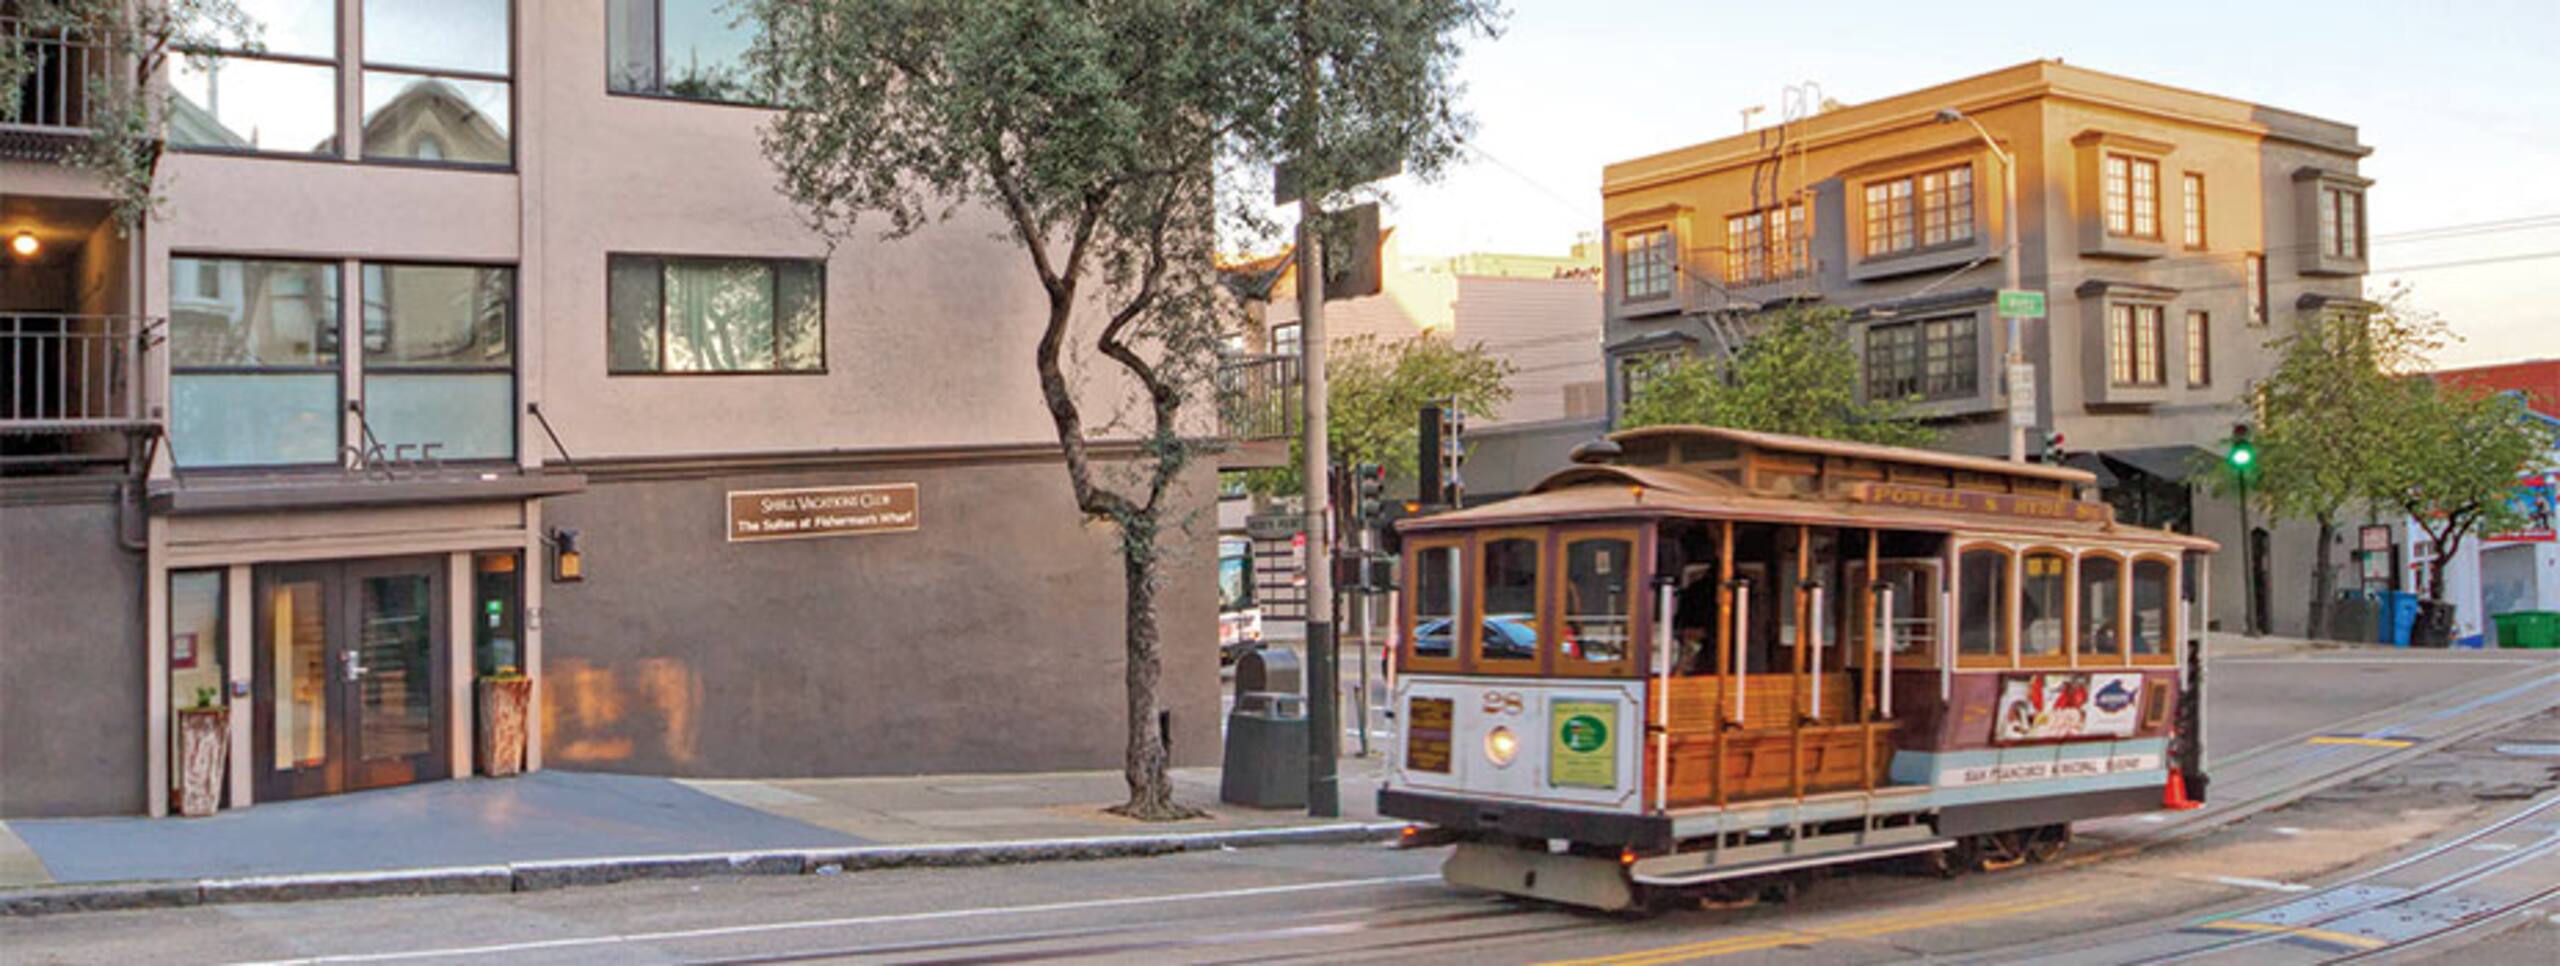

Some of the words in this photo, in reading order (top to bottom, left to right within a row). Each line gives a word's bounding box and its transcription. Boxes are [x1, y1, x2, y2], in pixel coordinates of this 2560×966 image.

[797, 495, 858, 511] VACATIONS
[860, 494, 890, 508] CLUB
[1873, 486, 1965, 509] POWELL
[2014, 500, 2067, 516] HYDE
[738, 520, 759, 532] The
[763, 518, 797, 531] Suites
[799, 517, 811, 529] at
[880, 511, 913, 525] Wharf
[1482, 690, 1524, 717] 28
[1964, 770, 1987, 783] SAN
[1989, 765, 2045, 781] FRANCISCO
